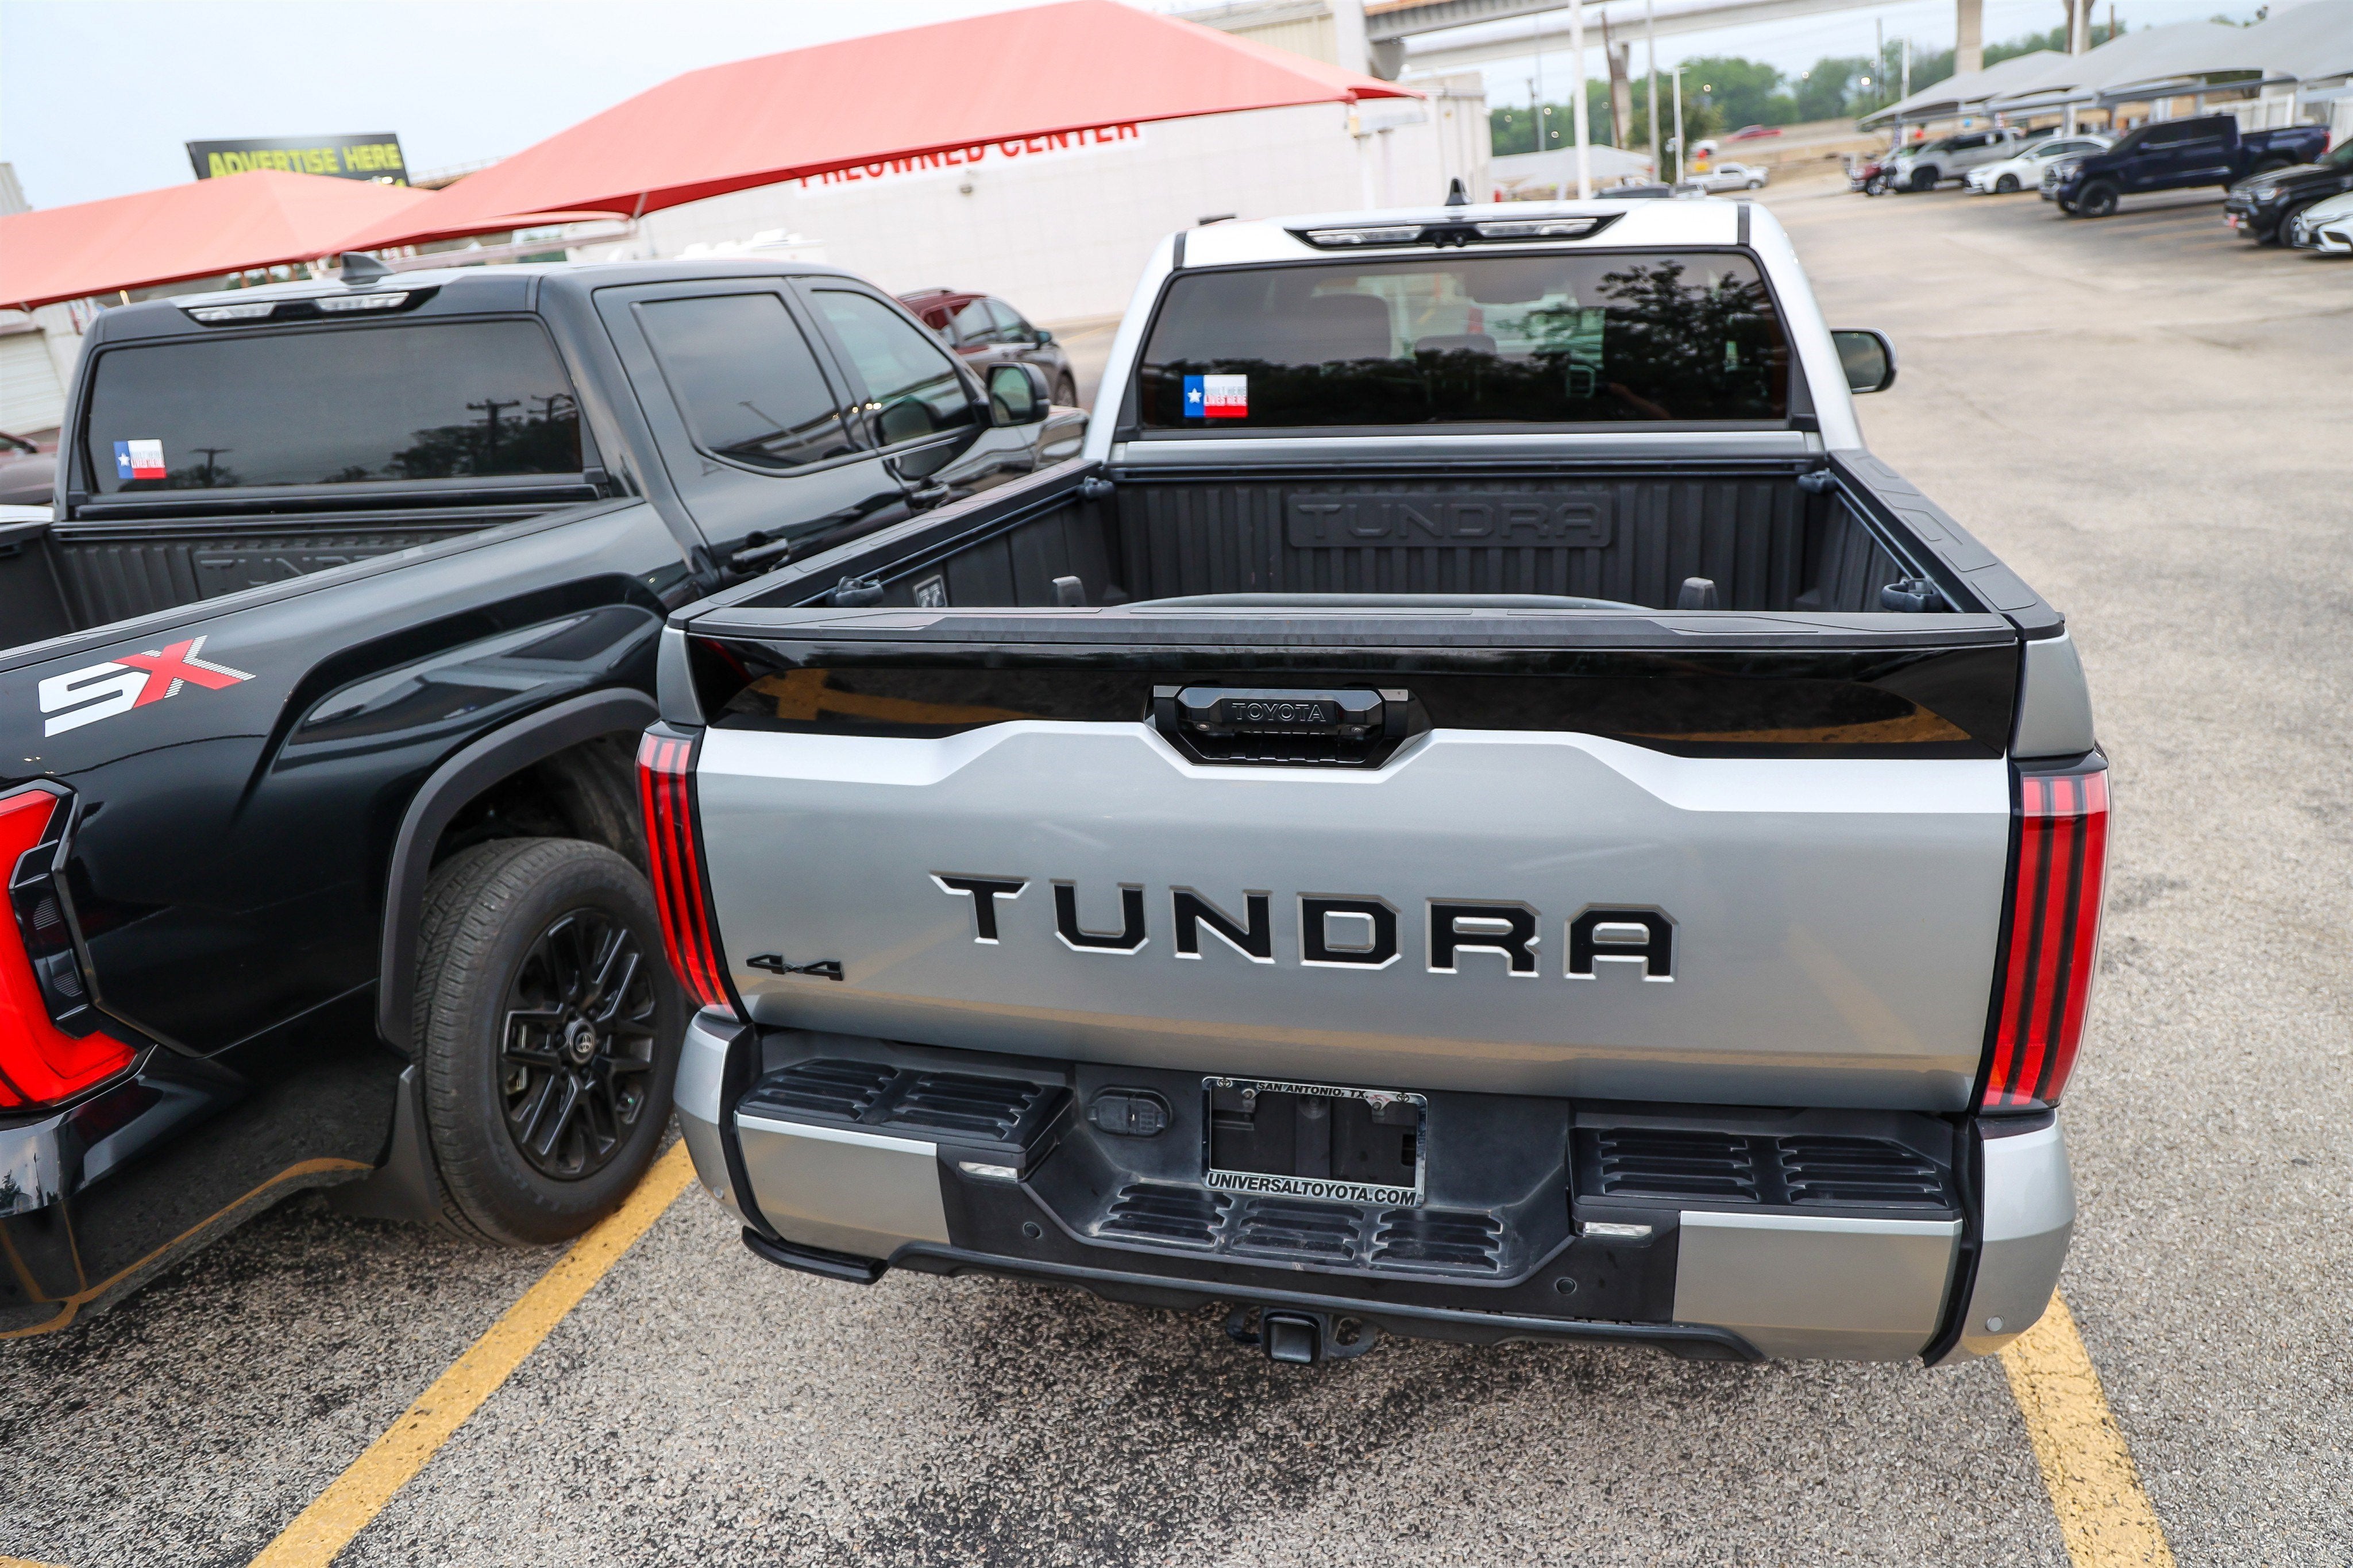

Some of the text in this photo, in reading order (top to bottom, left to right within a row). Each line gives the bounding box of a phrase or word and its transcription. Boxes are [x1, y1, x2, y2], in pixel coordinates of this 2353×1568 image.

[207, 143, 403, 177] ADVERTISE HERE
[1297, 502, 1603, 538] TUNDRA
[37, 635, 256, 738] SX
[1232, 702, 1326, 722] TOYOTA
[929, 869, 1679, 983] TUNDRA
[1257, 1082, 1283, 1092] SAN
[1286, 1084, 1345, 1098] ANTONIO,
[1208, 1172, 1417, 1207] UNIVERSALTOYOTA.COM
